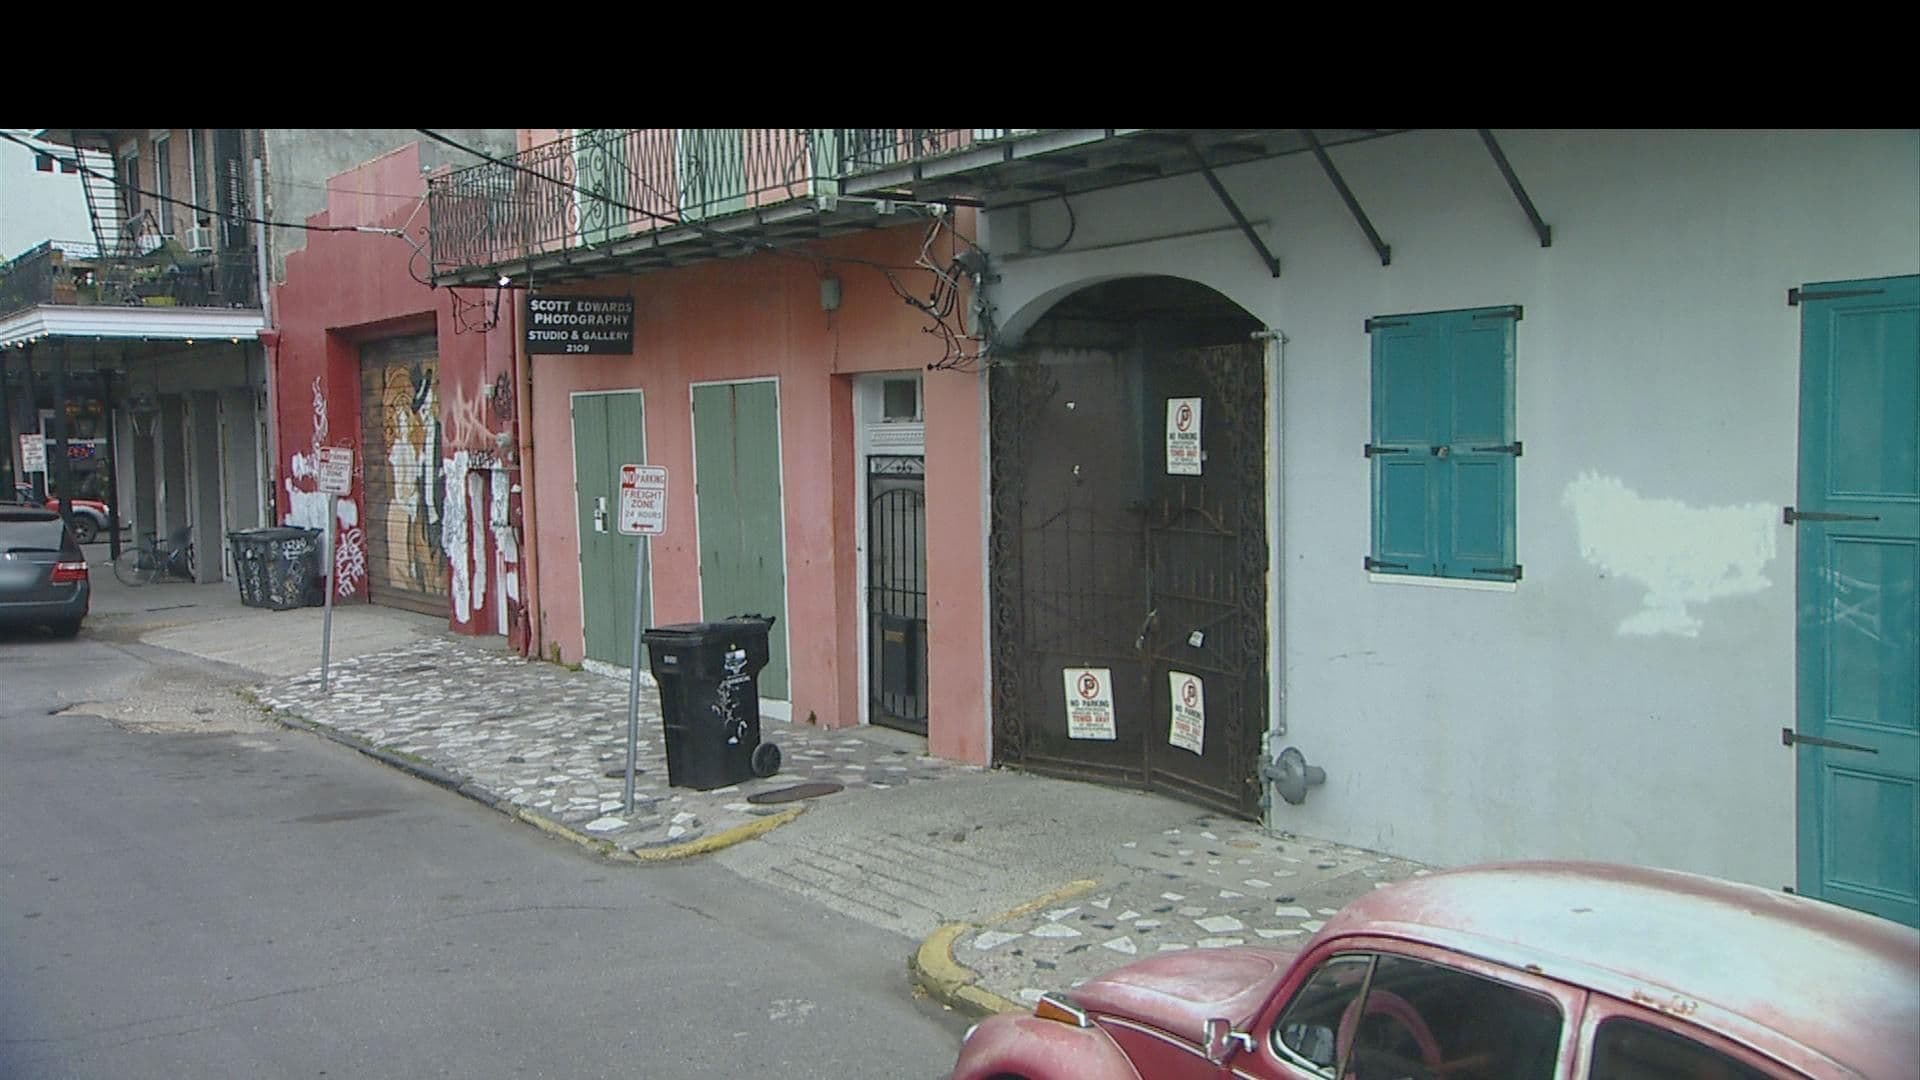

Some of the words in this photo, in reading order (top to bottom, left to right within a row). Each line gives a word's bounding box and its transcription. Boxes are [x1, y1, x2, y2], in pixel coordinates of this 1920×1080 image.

[530, 300, 571, 311] SCOTT
[577, 302, 632, 312] EDWARDS
[534, 313, 629, 325] PHOTOGRAPHY
[528, 331, 569, 341] STUDIO
[571, 331, 579, 340] &
[582, 331, 629, 341] GALLERY
[566, 344, 590, 353] 2109
[1169, 432, 1176, 440] NO
[1178, 432, 1198, 440] PARKING
[623, 471, 635, 484] NO
[636, 473, 665, 484] PARKING
[624, 490, 662, 499] FREIGHT
[631, 499, 655, 508] ZONE
[638, 511, 661, 519] HOURS
[1083, 700, 1109, 708] PARKING
[1175, 704, 1182, 712] NO
